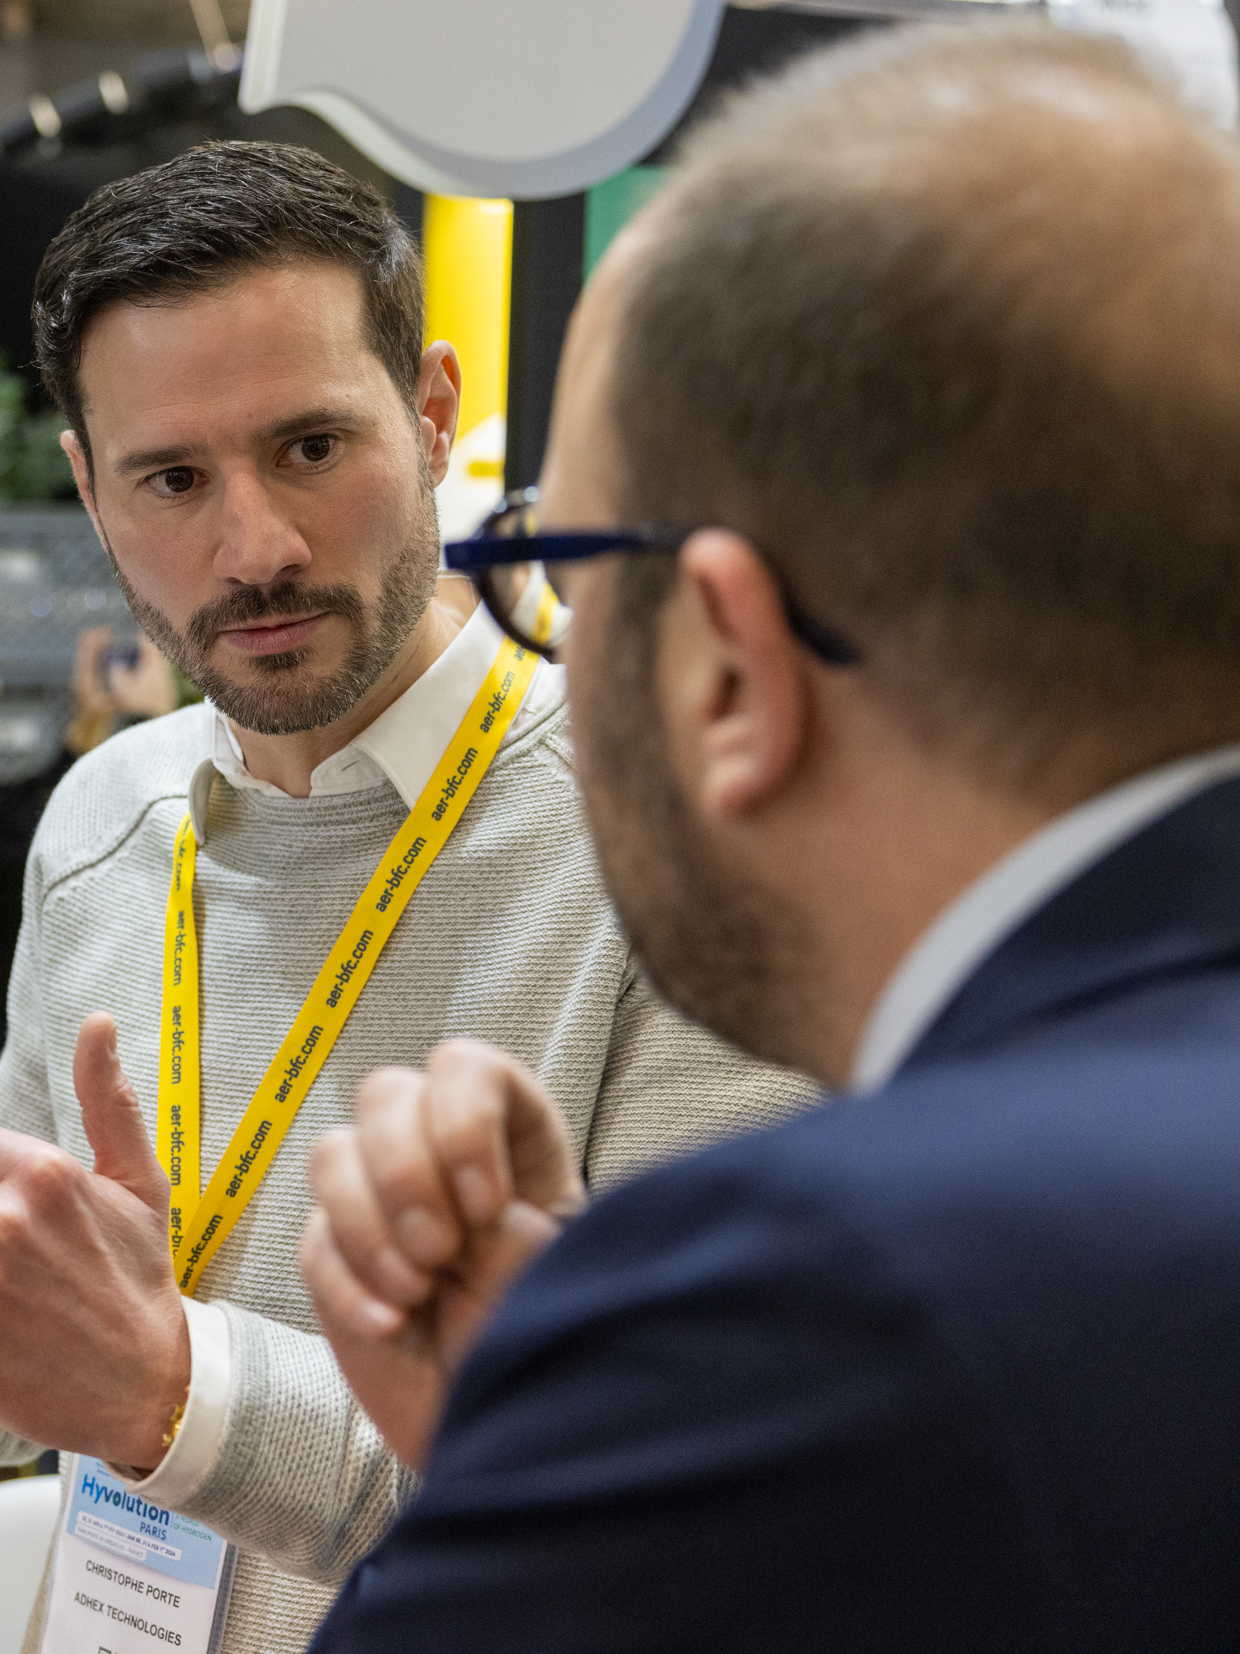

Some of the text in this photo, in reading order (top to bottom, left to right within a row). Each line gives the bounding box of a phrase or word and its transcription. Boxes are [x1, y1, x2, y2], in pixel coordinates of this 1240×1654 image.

[479, 670, 516, 734] aer-bfc.com
[431, 746, 479, 822] aer-bfc.com
[375, 836, 427, 913] aer-bfc.com
[173, 910, 187, 987] aer-bfc.com
[325, 928, 374, 1009] aer-bfc.com
[172, 1005, 186, 1085] aer-bfc.com
[274, 1024, 324, 1104] aer-bfc.com
[170, 1104, 185, 1187] aer-bfc.com
[225, 1119, 273, 1198] aer-bfc.com
[180, 1214, 223, 1289] aer-bfc.com
[81, 1473, 170, 1526] Hyvolution
[139, 1522, 167, 1541] PARIS
[73, 1591, 182, 1647] ADHEX TECHNOLOGIES
[85, 1559, 181, 1608] CHRISTOPHE PORTE
